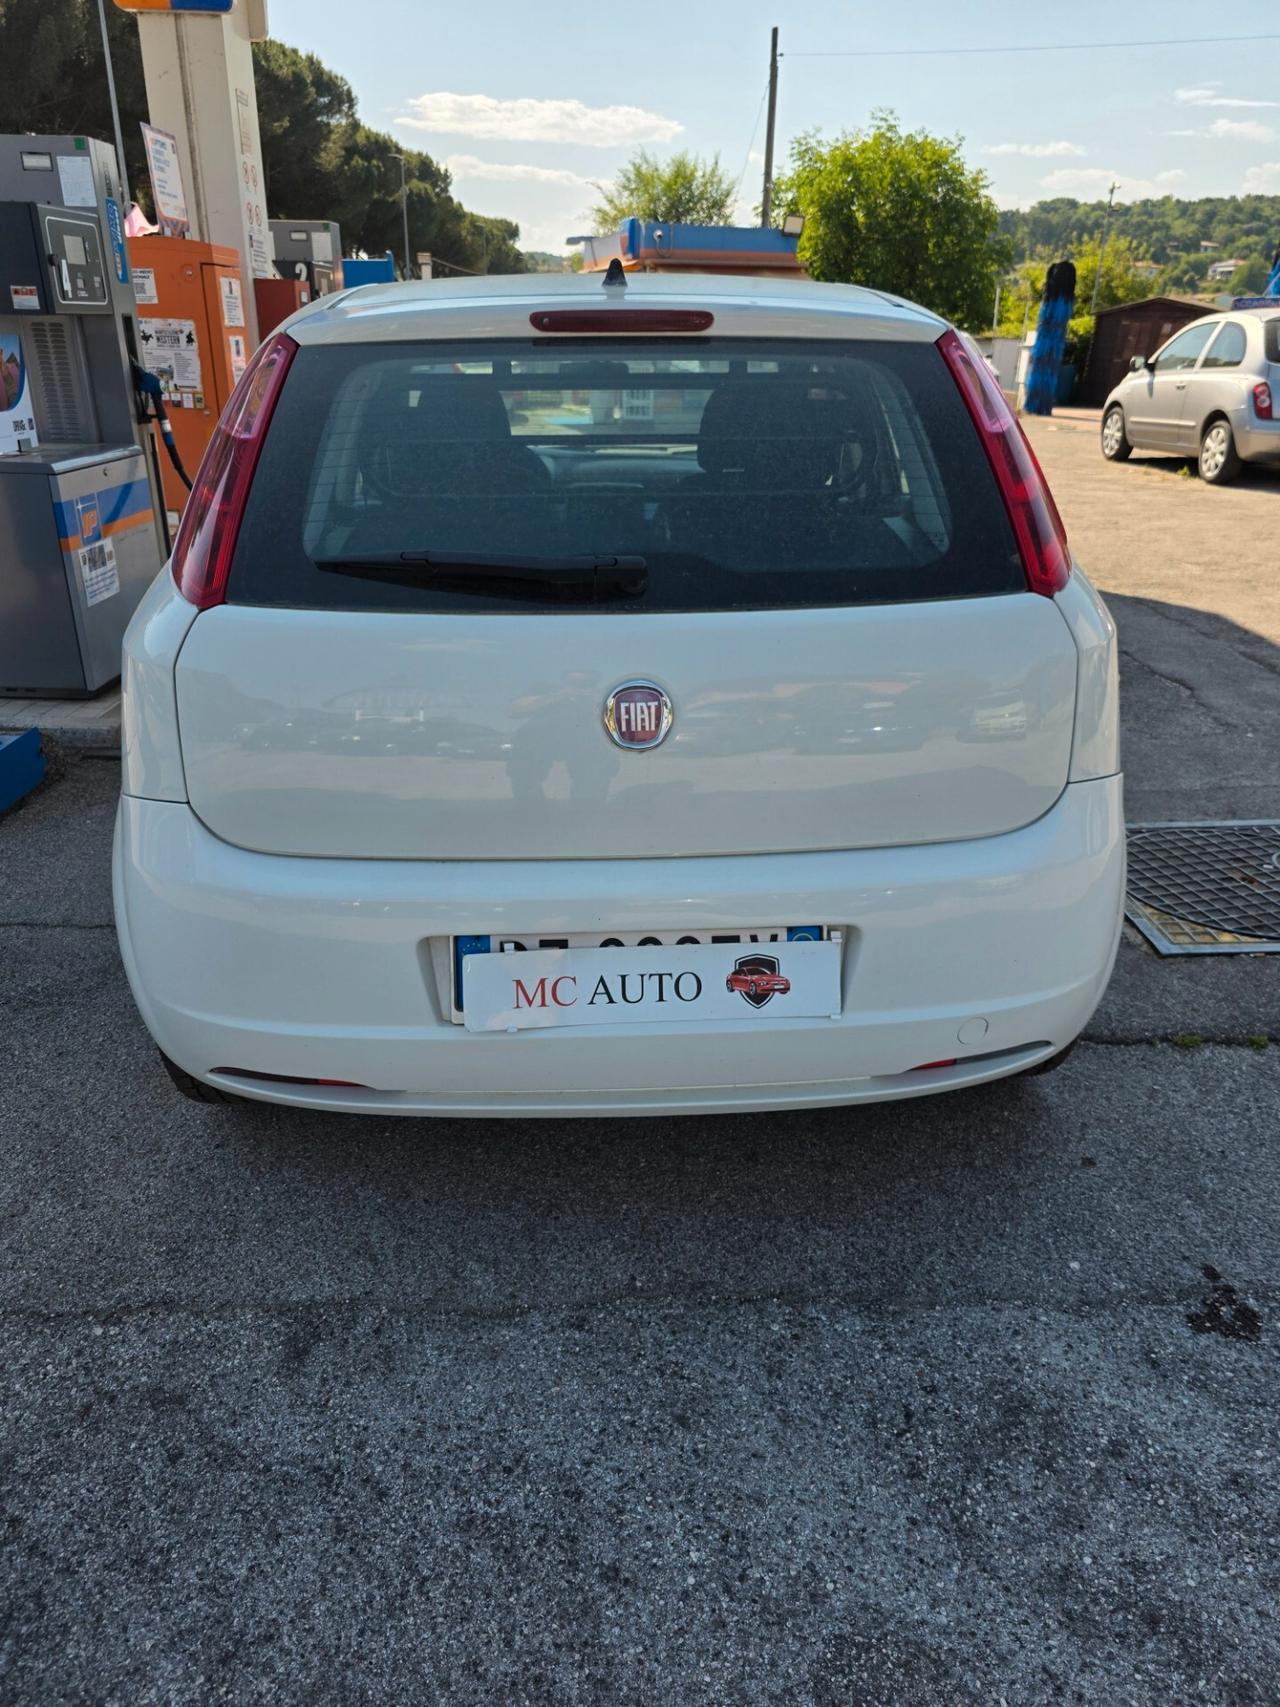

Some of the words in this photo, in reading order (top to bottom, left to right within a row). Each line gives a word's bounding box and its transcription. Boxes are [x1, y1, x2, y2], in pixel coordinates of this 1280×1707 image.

[620, 701, 659, 732] FIAT
[512, 975, 578, 1010] MC
[587, 970, 703, 1006] AUTO
